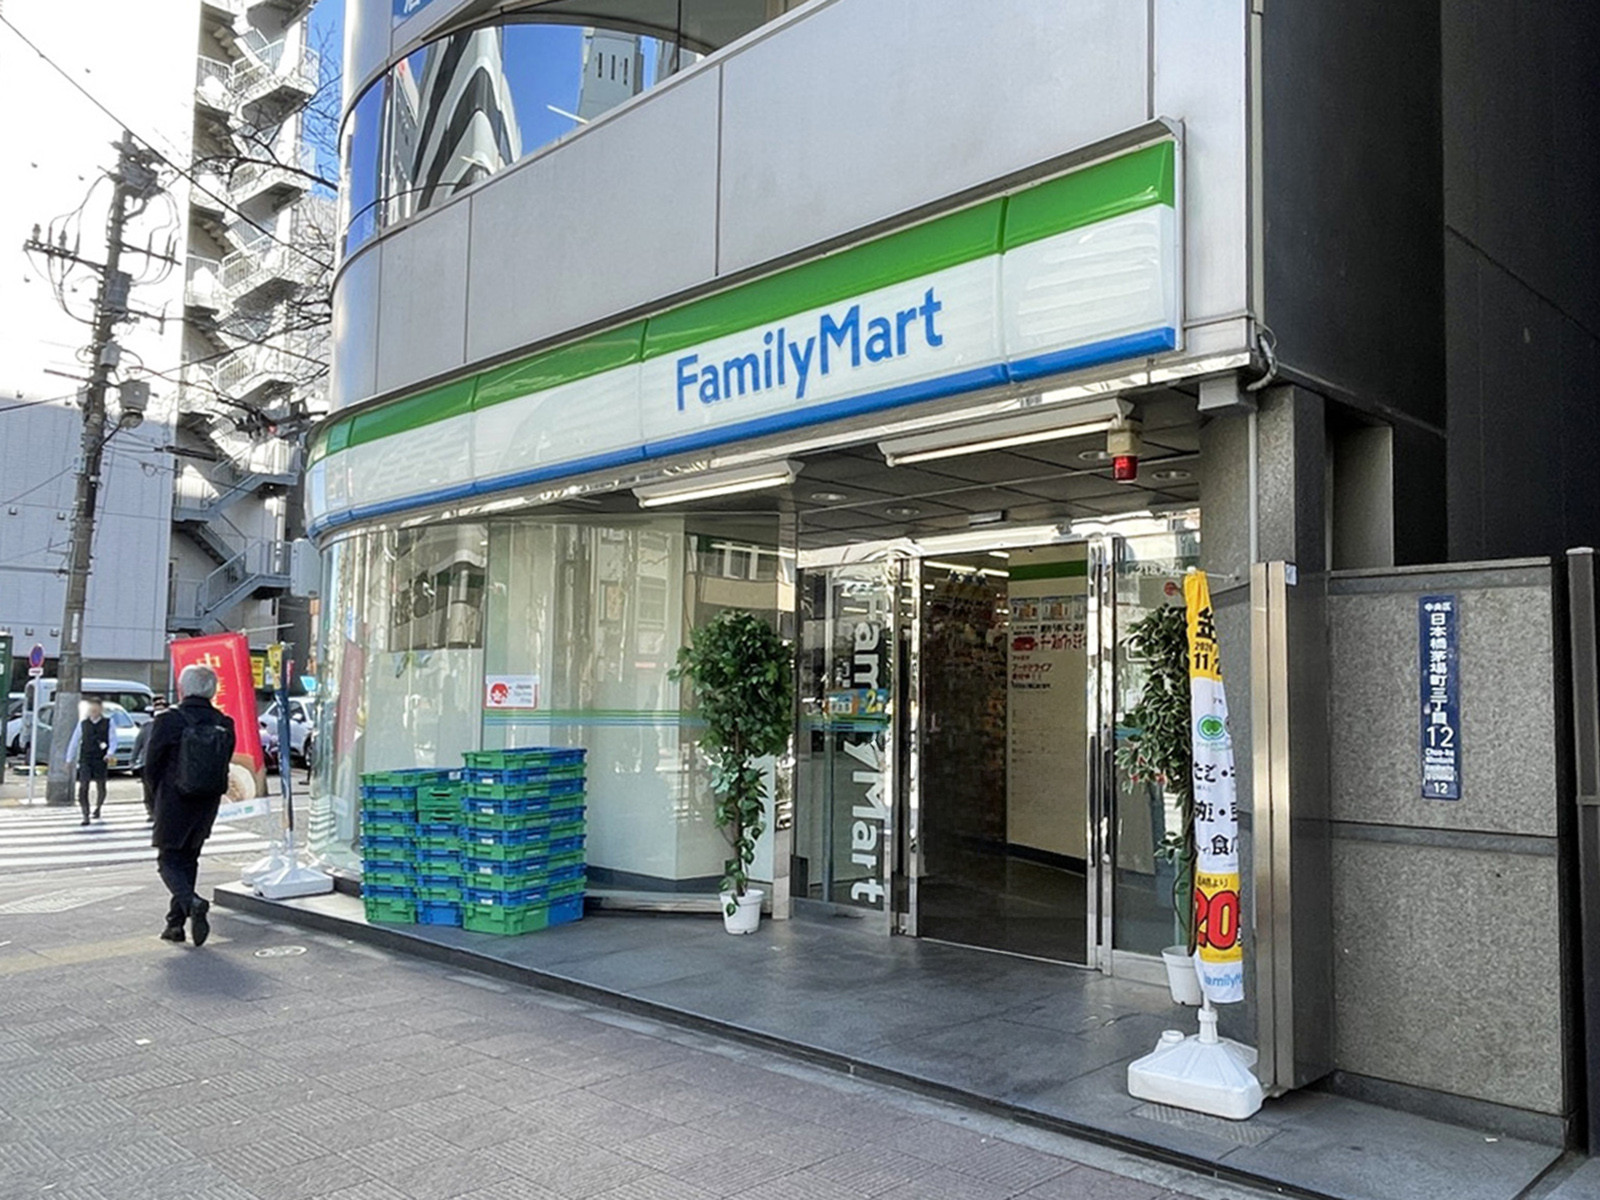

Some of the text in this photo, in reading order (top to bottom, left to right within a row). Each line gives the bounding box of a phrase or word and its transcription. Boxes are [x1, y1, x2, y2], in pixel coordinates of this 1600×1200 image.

[676, 287, 943, 411] FamilyMart
[1426, 726, 1454, 747] 12
[1433, 782, 1448, 793] 12
